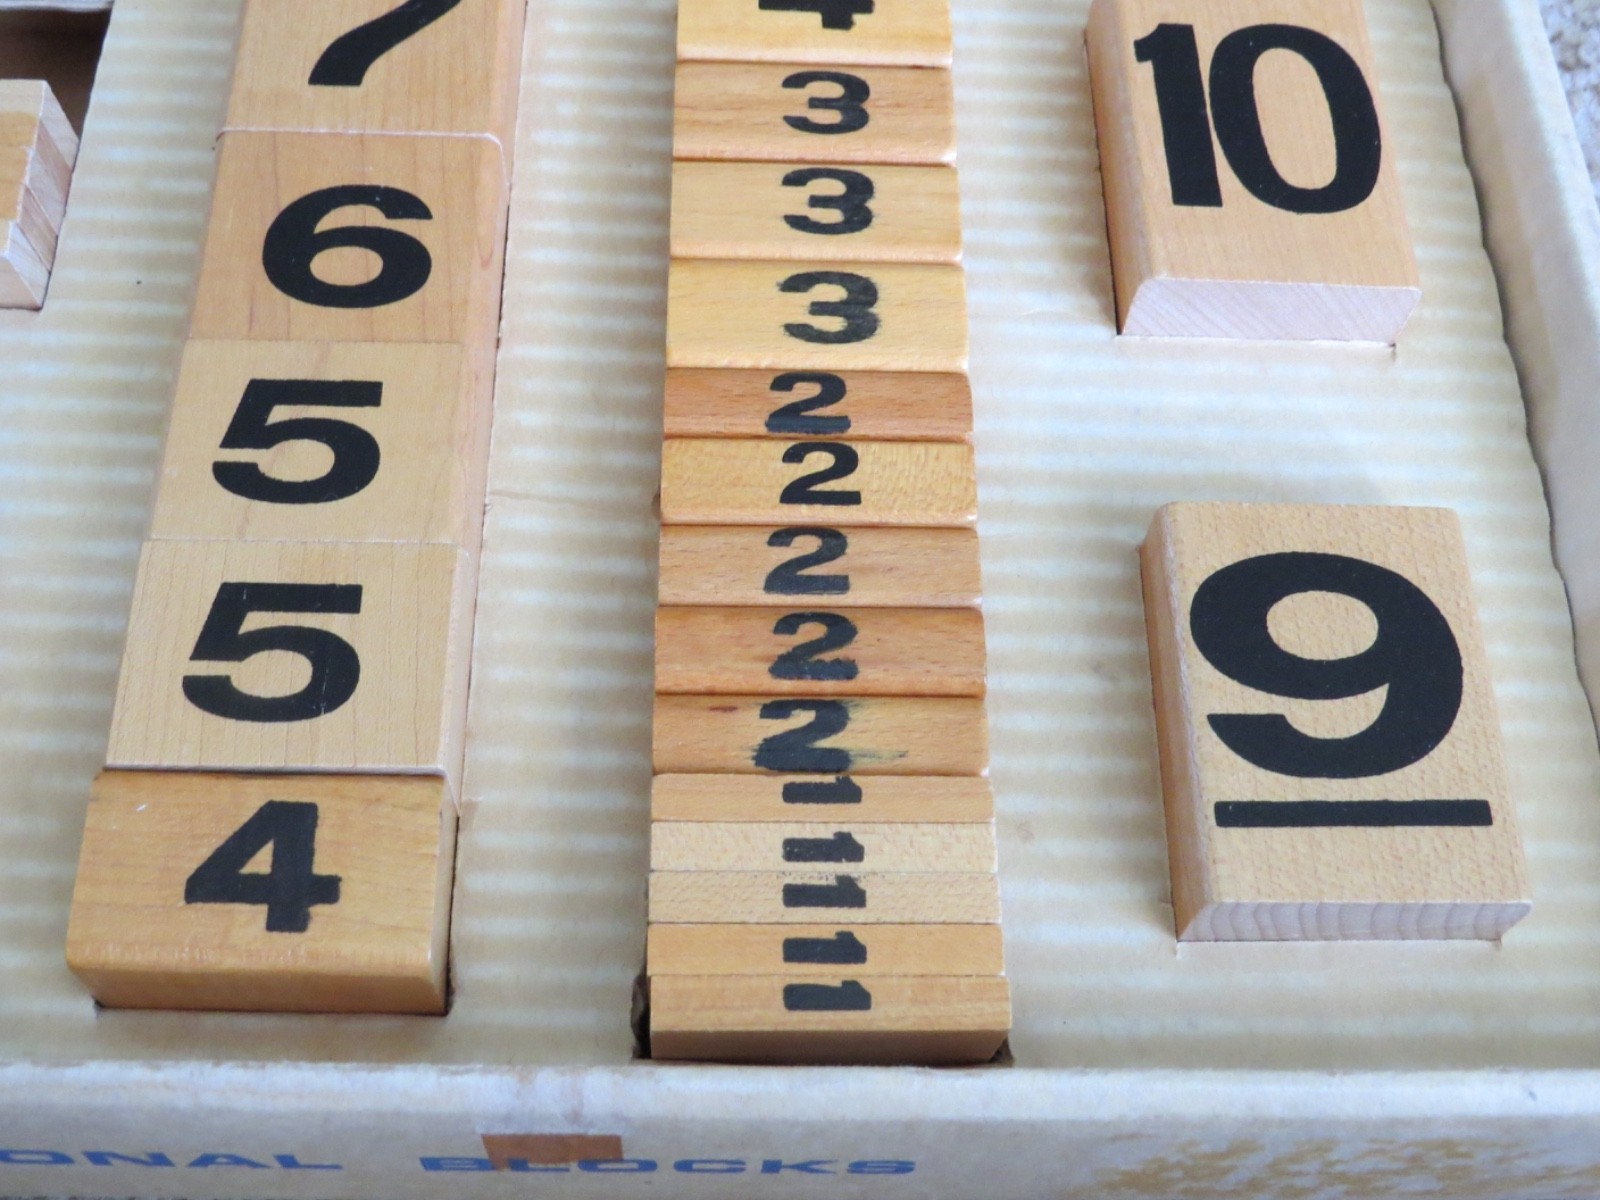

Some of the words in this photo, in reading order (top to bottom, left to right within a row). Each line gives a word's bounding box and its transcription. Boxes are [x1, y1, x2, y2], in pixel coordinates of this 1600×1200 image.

[781, 71, 870, 135] 3
[1133, 23, 1382, 215] 10
[781, 168, 875, 235] 3
[262, 184, 433, 309] 6
[779, 271, 879, 344] 3
[764, 371, 851, 434] 2
[213, 379, 382, 505] 5
[779, 441, 862, 505] 2
[763, 527, 850, 594] 2
[182, 582, 362, 723] 5
[768, 611, 859, 680] 2
[1189, 551, 1464, 779] 9
[751, 699, 851, 773] 2
[782, 776, 862, 804] 1
[184, 801, 340, 933] 4
[782, 831, 864, 862] 1
[782, 874, 866, 908] 1
[783, 931, 867, 963] 1
[783, 980, 871, 1011] 1
[419, 1157, 916, 1175] BLOCKS
